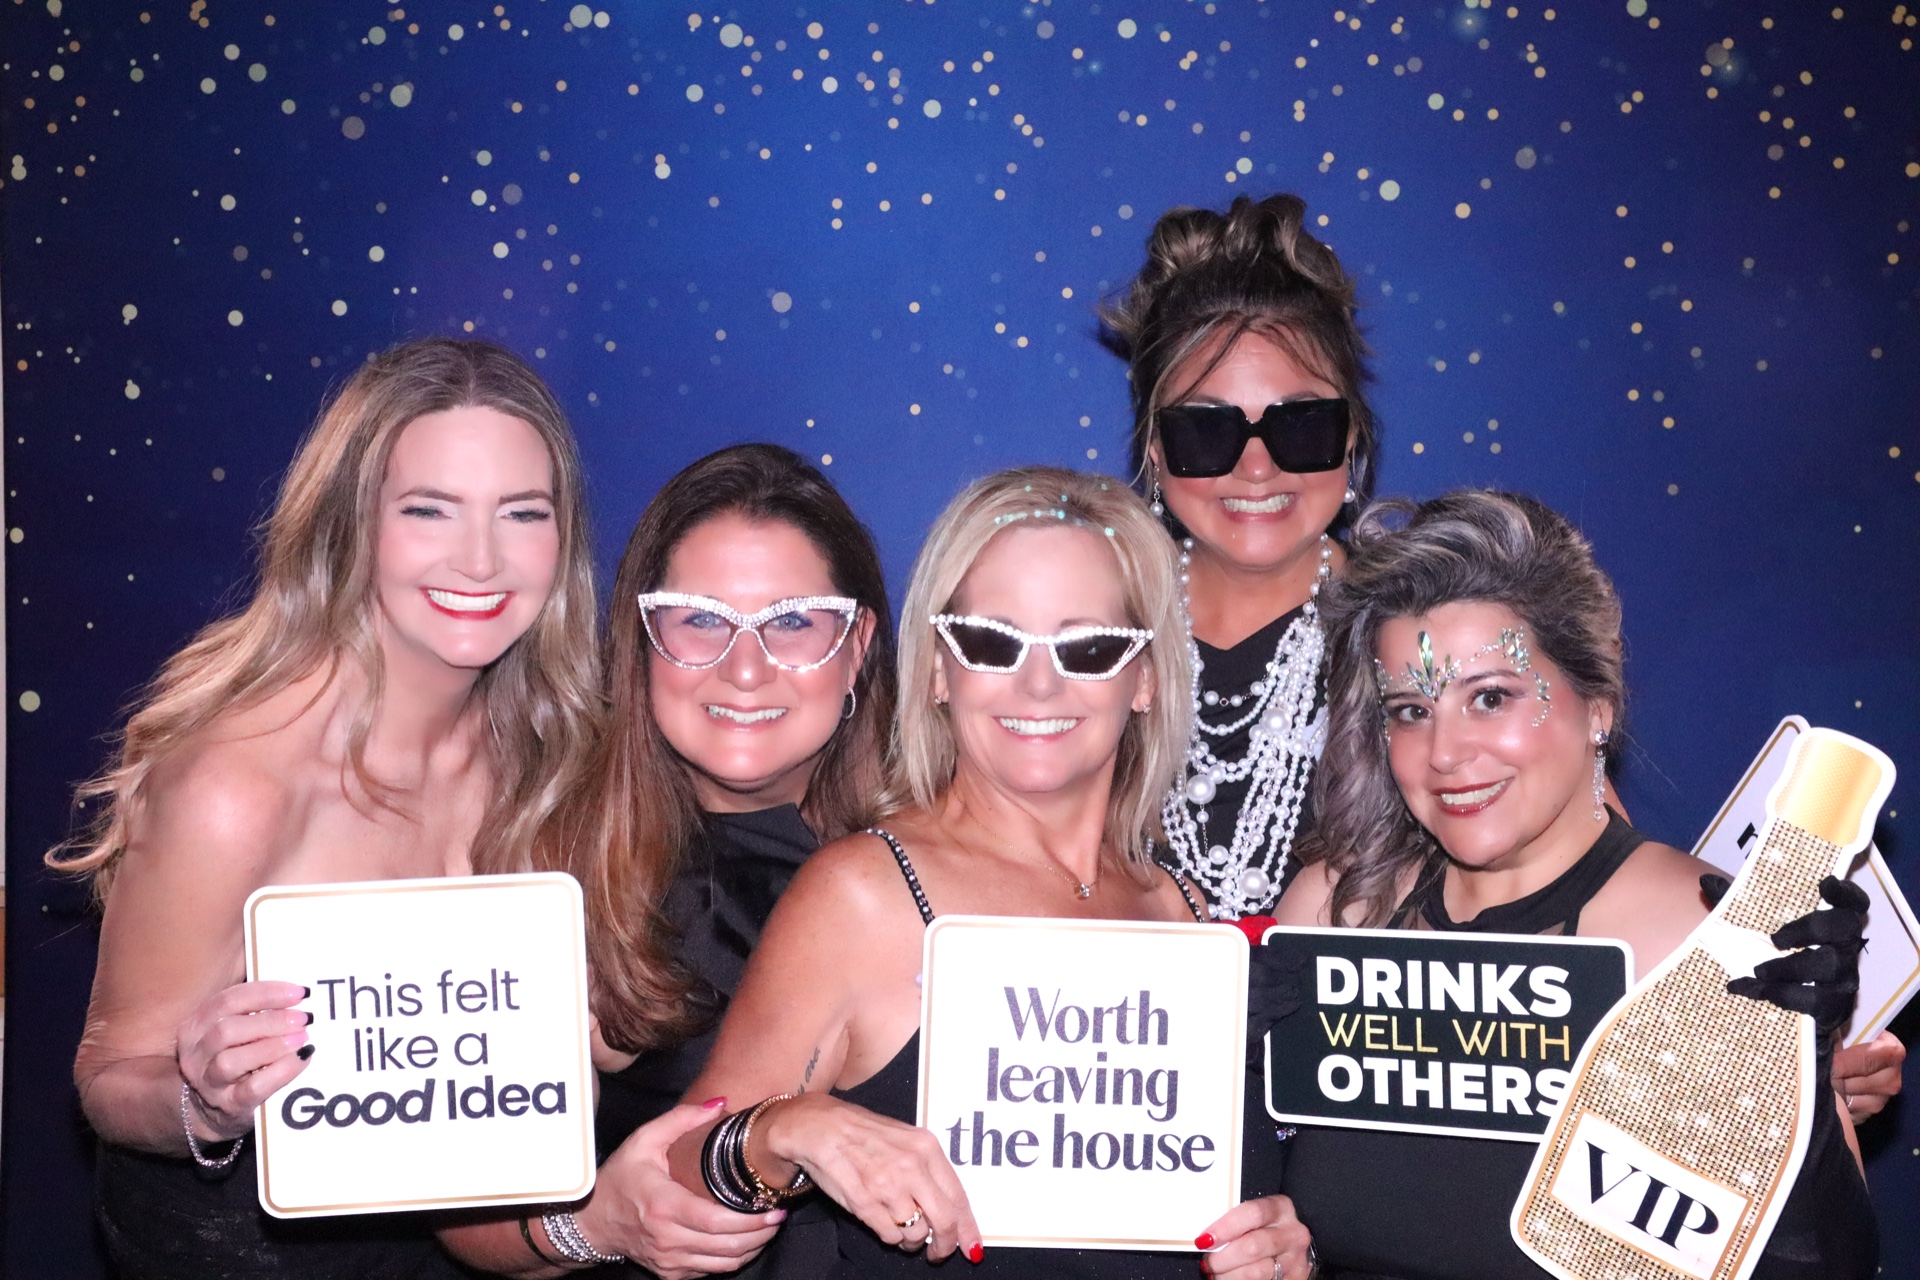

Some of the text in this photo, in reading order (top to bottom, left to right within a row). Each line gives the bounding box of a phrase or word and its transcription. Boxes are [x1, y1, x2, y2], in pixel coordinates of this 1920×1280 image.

[316, 968, 520, 1020] This felt
[1003, 986, 1169, 1045] Worth
[1316, 956, 1572, 1018] DRINKS
[354, 1026, 489, 1072] like a
[1318, 1011, 1571, 1061] WELL WITH
[281, 1075, 567, 1131] Good Idea
[986, 1047, 1179, 1122] leaving
[1317, 1054, 1571, 1118] OTHERS
[945, 1111, 1216, 1173] the house
[1584, 1140, 1720, 1251] VIP
